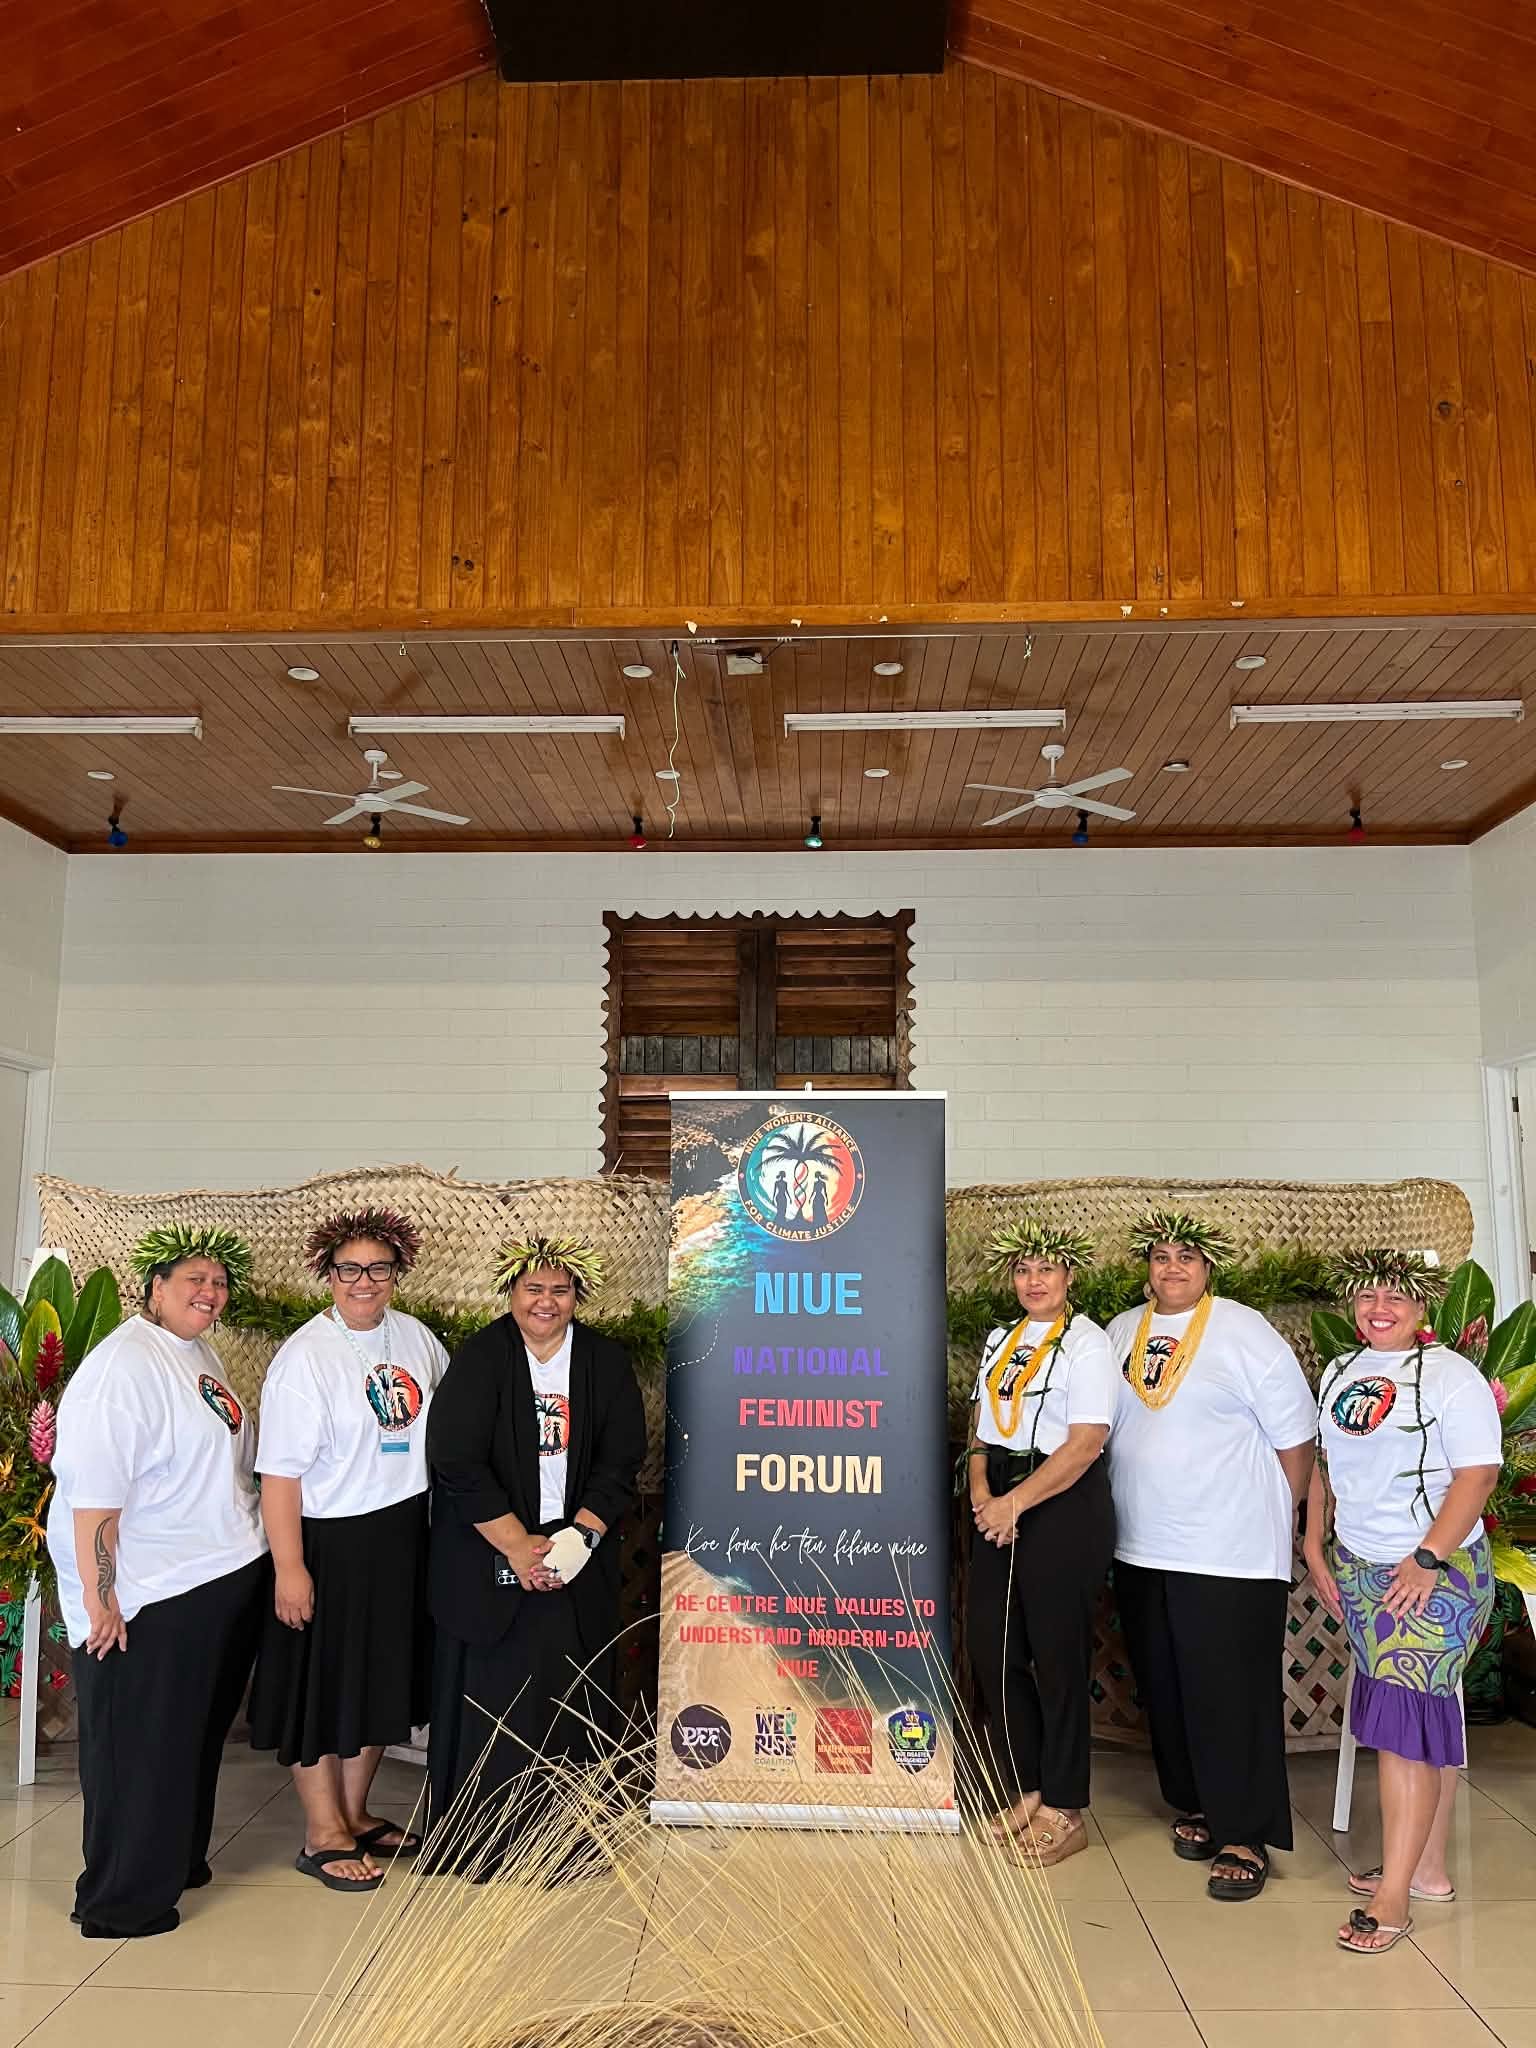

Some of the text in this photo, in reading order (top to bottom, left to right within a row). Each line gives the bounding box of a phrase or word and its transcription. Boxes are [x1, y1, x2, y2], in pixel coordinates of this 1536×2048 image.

[745, 1114, 858, 1154] NIUE WOMEN'S ALLIANCE
[744, 1199, 855, 1239] FOR CLIMATE JUSTICE
[754, 1271, 863, 1315] NIUE
[733, 1347, 889, 1376] NATIONAL
[738, 1398, 883, 1428] FEMINIST
[736, 1453, 882, 1494] FORUM
[685, 1523, 720, 1560] Koe
[770, 1525, 791, 1560] he
[676, 1595, 936, 1617] RE-CENTRE NIUE VALUES TO
[680, 1626, 932, 1649] UNDERSTAND MODERN-DAY
[777, 1660, 819, 1678] NIUE
[754, 1735, 797, 1757] RISE
